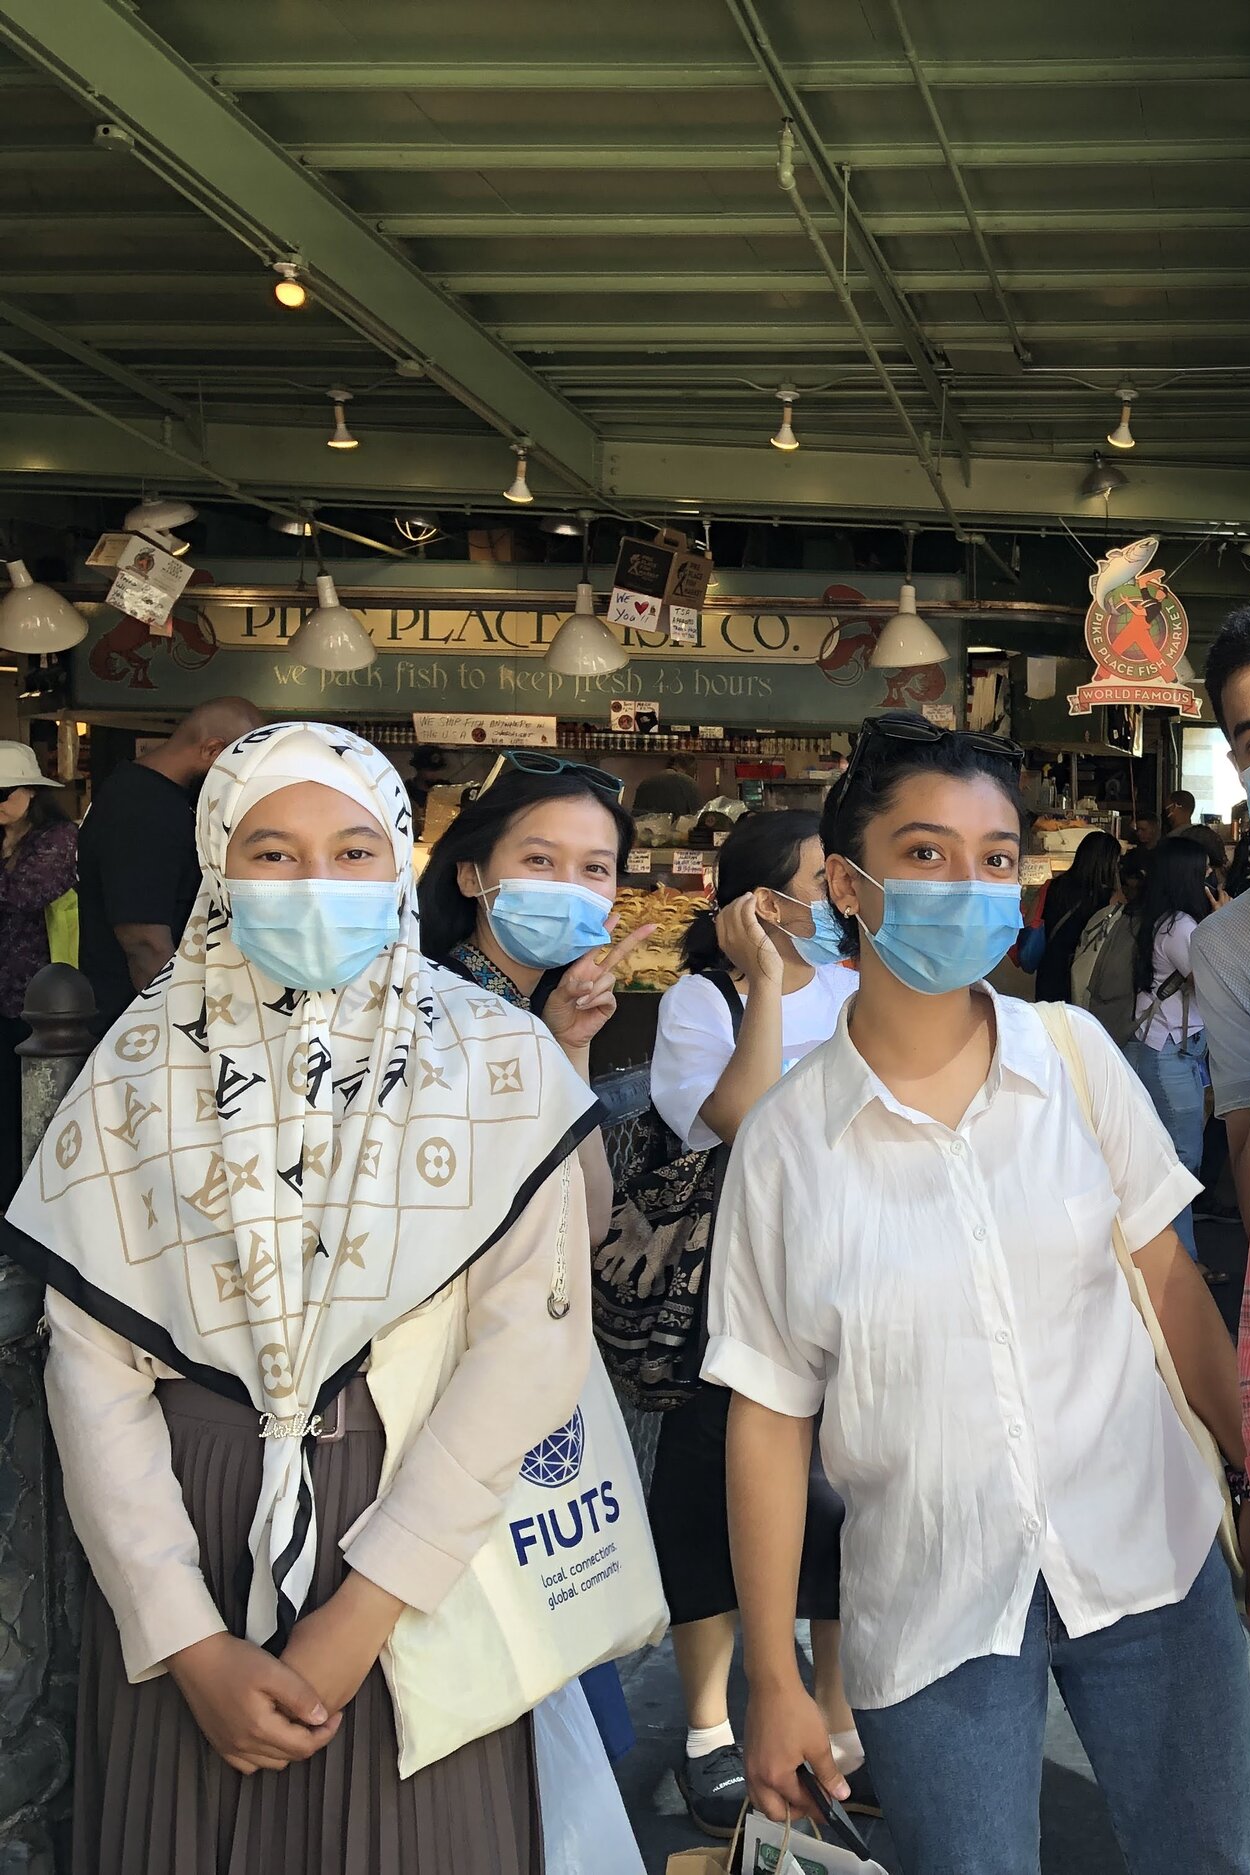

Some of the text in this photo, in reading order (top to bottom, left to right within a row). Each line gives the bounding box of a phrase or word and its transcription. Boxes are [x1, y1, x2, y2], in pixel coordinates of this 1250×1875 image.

[616, 592, 631, 604] WE
[721, 613, 800, 652] CO.
[1091, 605, 1182, 677] PIKE PLACE FISH MARKET
[273, 663, 308, 686] we
[319, 662, 383, 693] pack
[396, 660, 449, 694] fish
[458, 662, 486, 690] to
[499, 663, 563, 699] keep
[573, 668, 642, 700] fresh
[694, 668, 773, 697] hours
[1082, 689, 1190, 704] WORLD FAMOUS
[419, 716, 435, 728] WE
[440, 716, 461, 728] SHIP
[509, 1480, 620, 1567] FIUTS
[540, 1540, 618, 1589] local connections.
[547, 1561, 622, 1611] global community.
